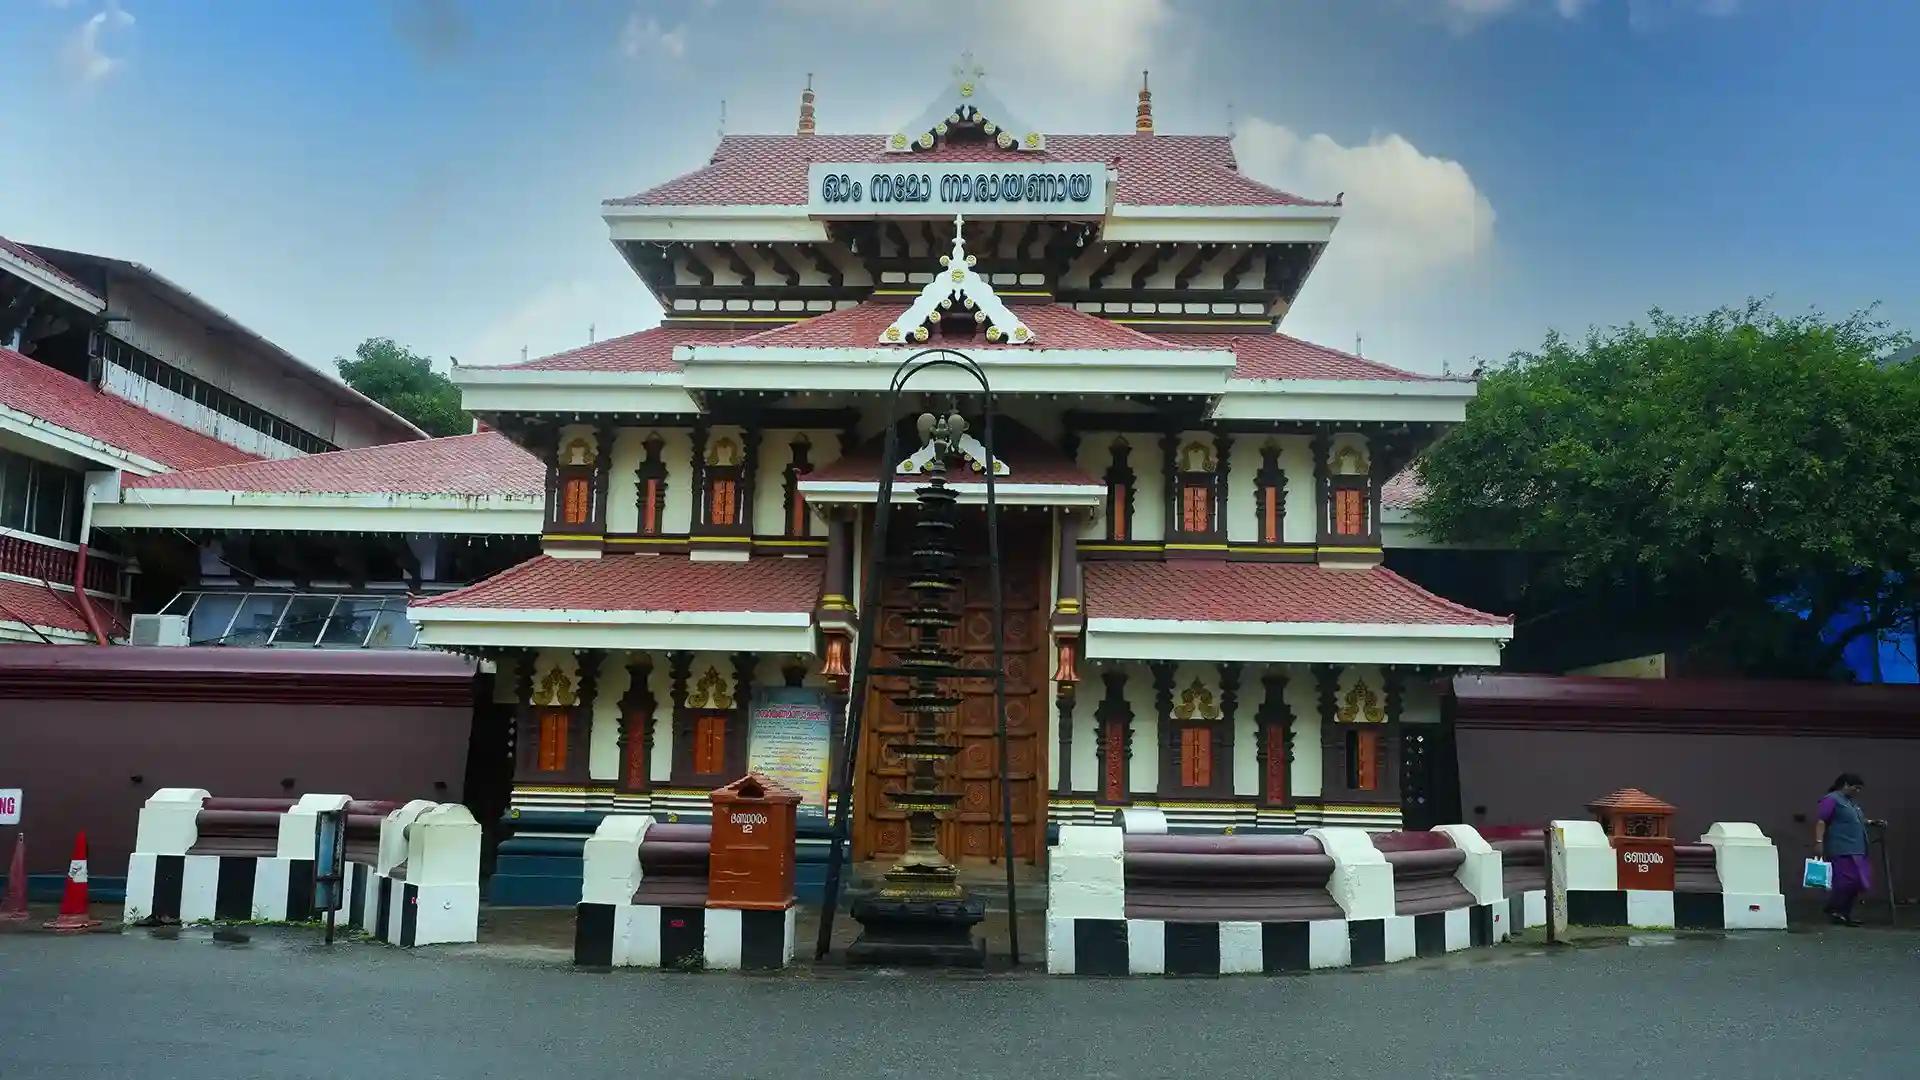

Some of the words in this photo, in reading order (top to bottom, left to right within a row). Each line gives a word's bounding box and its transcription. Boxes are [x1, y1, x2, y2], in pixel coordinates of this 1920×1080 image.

[822, 173, 862, 202] ഓം
[870, 173, 932, 202] നമോ
[940, 173, 1092, 202] നാരായണായ
[742, 824, 753, 833] 12
[1638, 864, 1649, 873] 13
